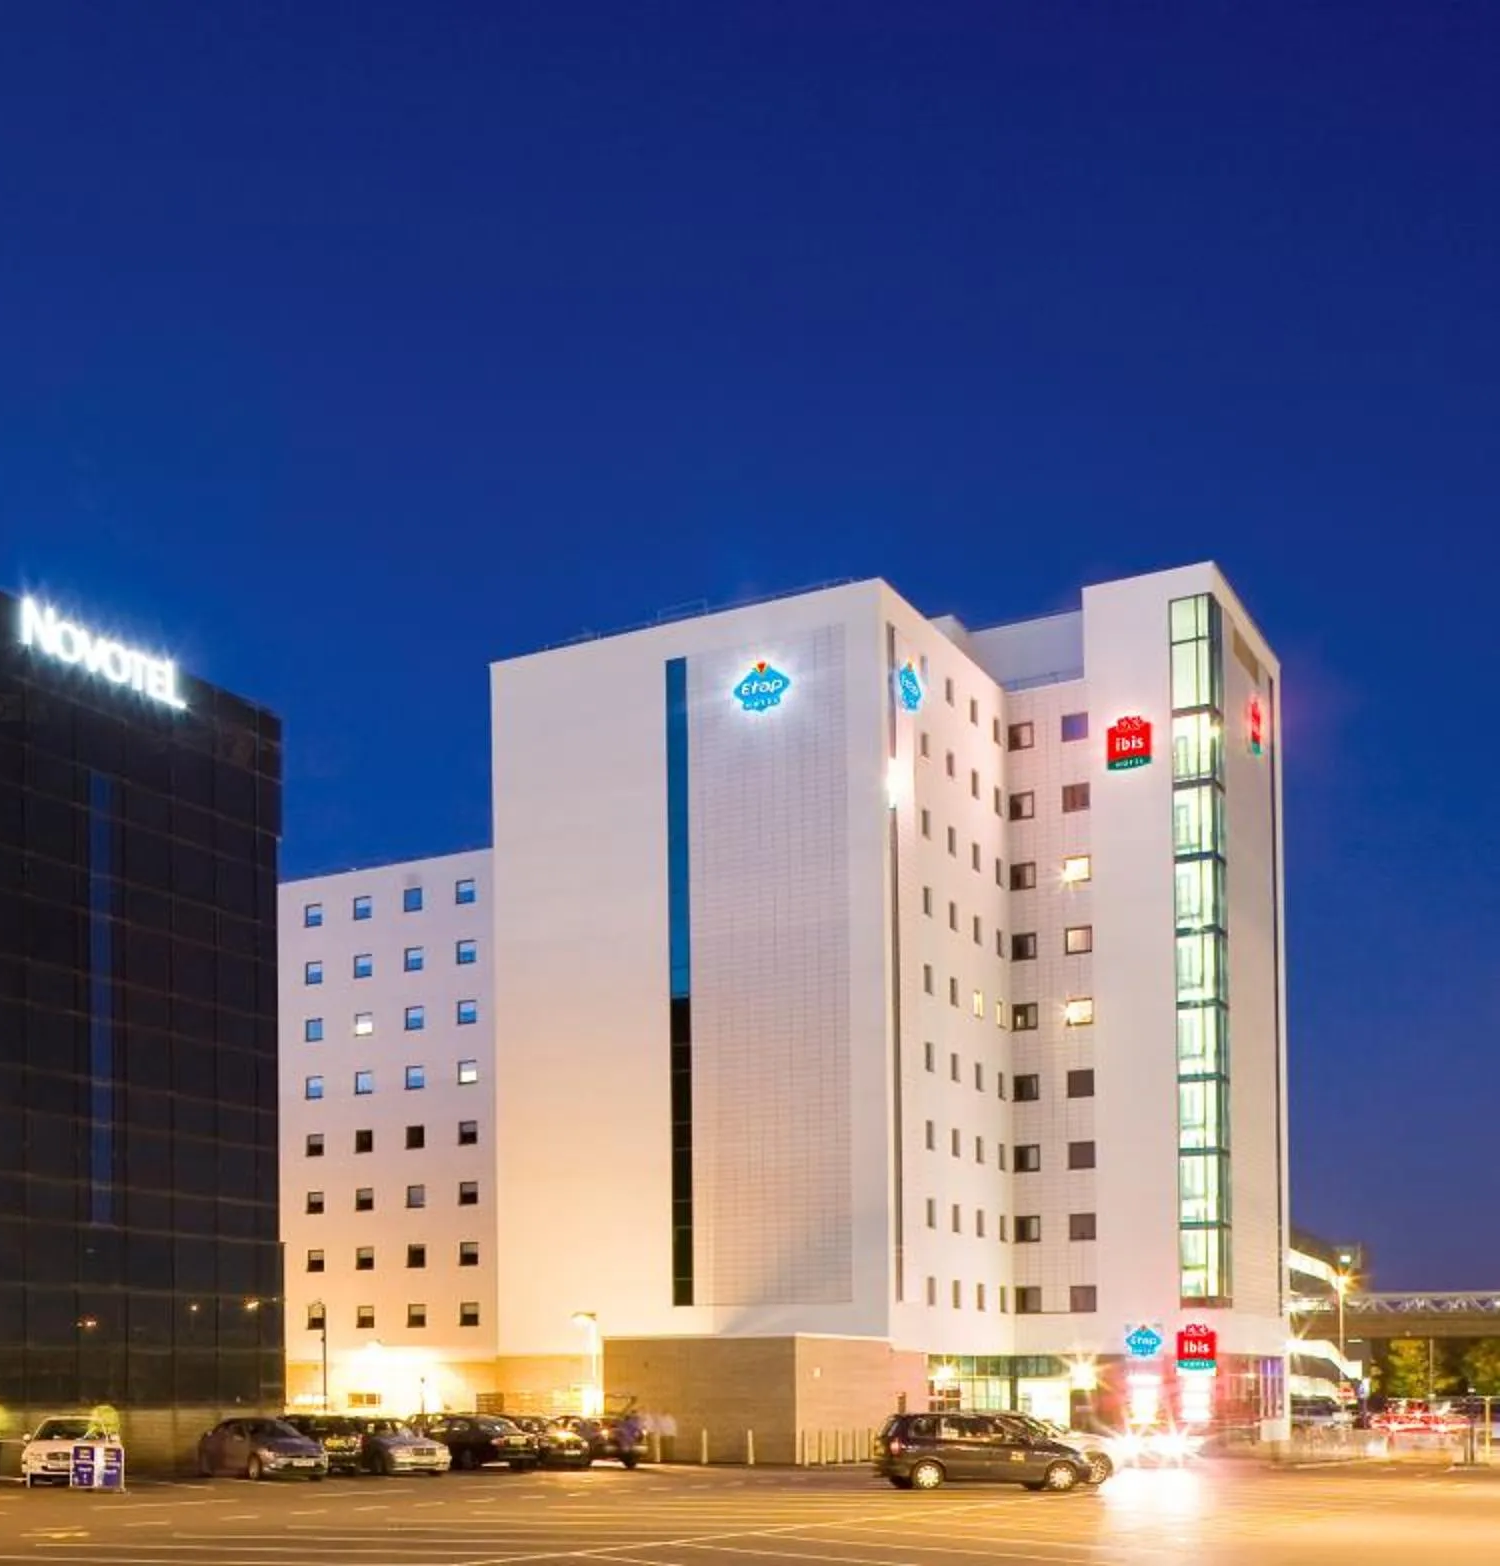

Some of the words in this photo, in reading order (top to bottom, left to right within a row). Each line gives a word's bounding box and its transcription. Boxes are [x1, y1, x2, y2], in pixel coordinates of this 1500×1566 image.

[20, 597, 187, 709] NOVOTEL
[1115, 735, 1145, 752] ibis
[1183, 1340, 1210, 1354] ibis
